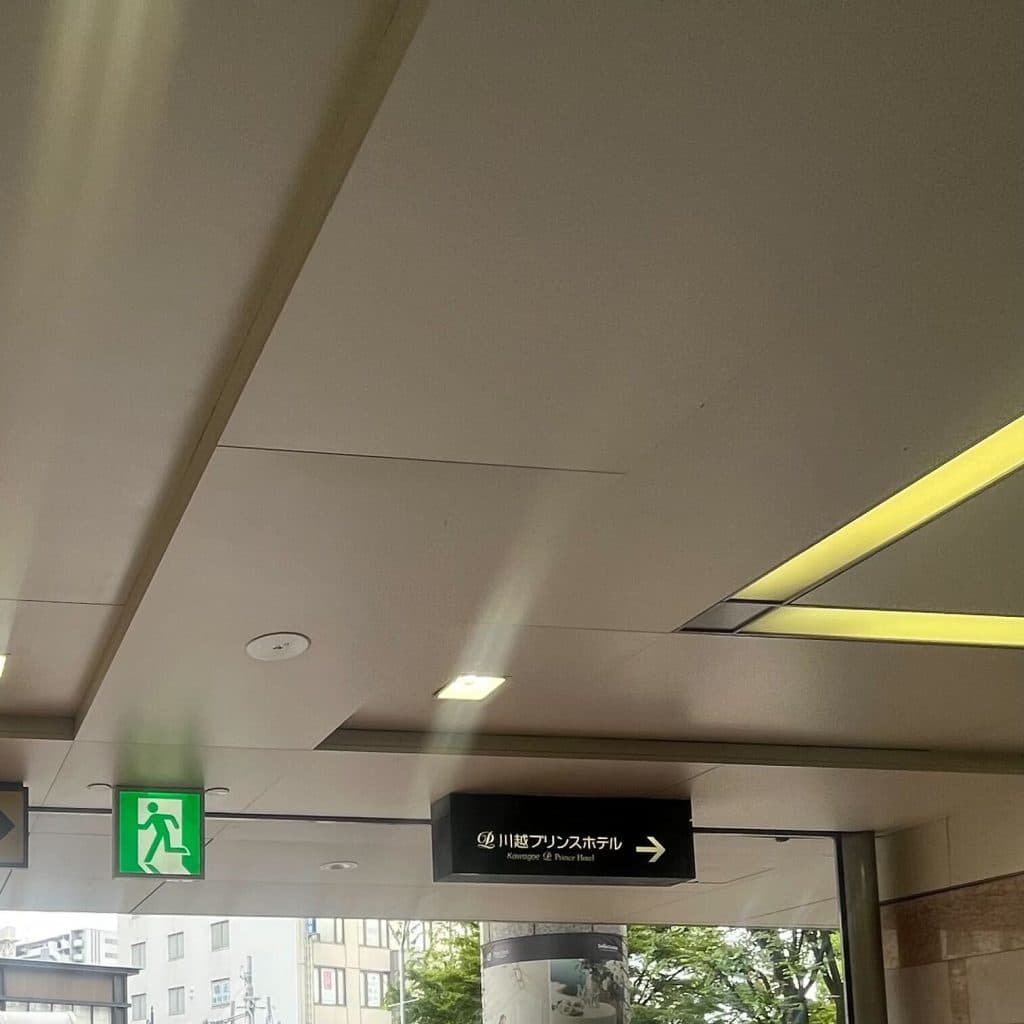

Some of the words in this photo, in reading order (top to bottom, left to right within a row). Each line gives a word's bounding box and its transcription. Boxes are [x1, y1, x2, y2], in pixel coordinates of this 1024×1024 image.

[499, 833, 623, 851] 川越プリンスホテル
